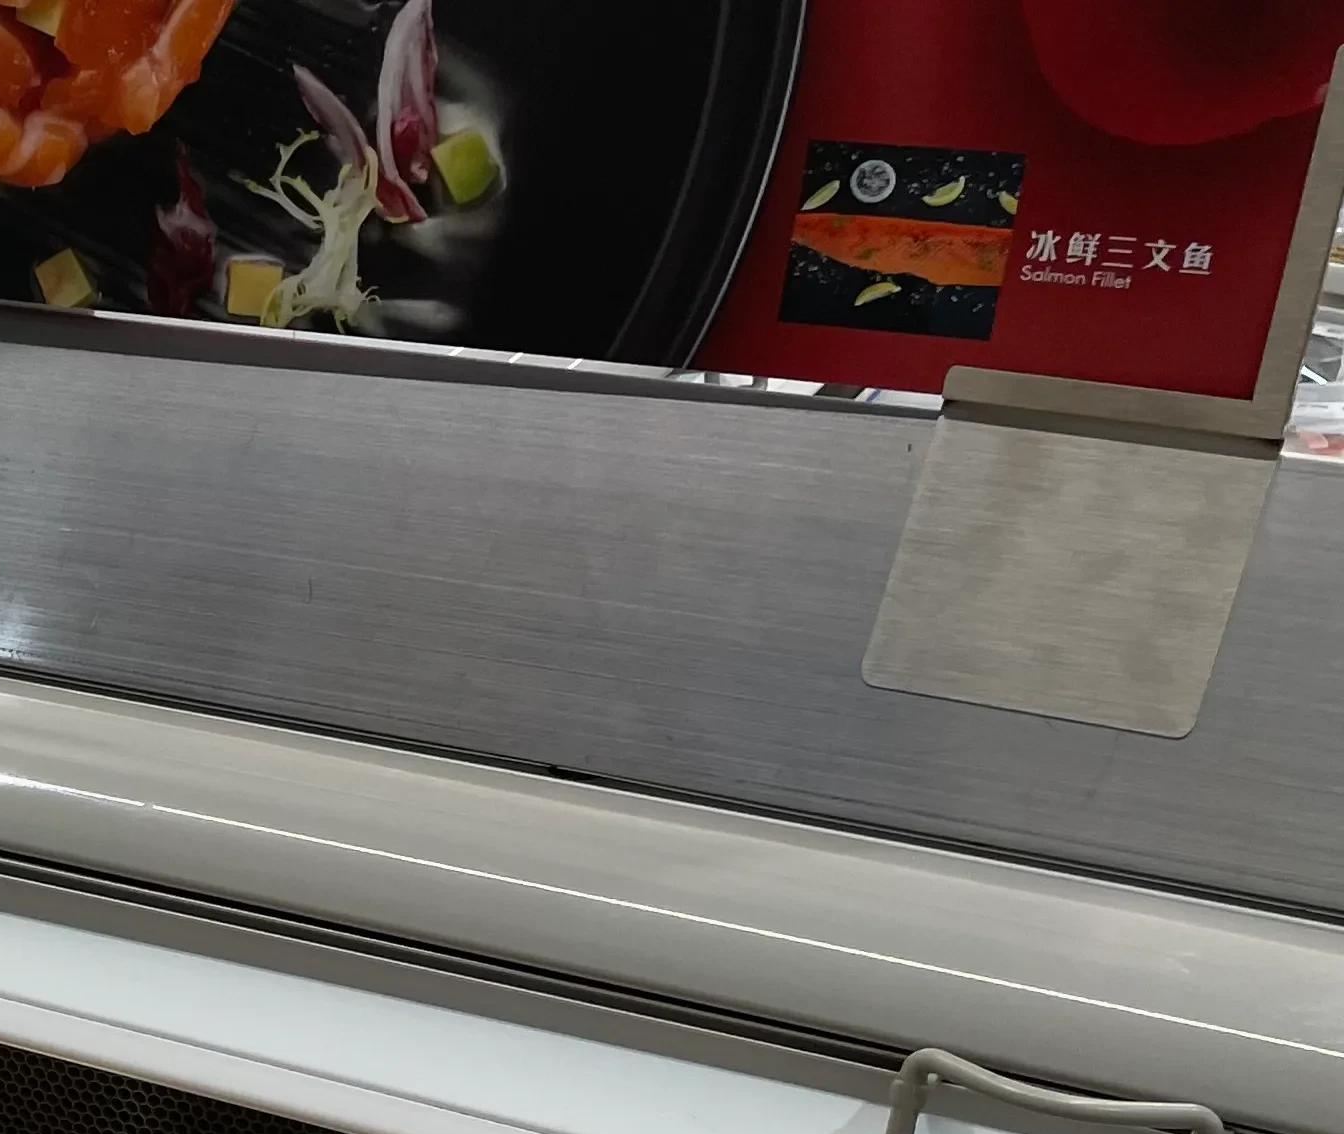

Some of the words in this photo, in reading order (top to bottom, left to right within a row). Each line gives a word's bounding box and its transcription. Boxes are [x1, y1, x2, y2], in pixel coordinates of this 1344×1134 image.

[1025, 230, 1214, 276] 冰鲜三文鱼
[1020, 264, 1086, 285] Salmon
[1091, 271, 1132, 289] Fillet
